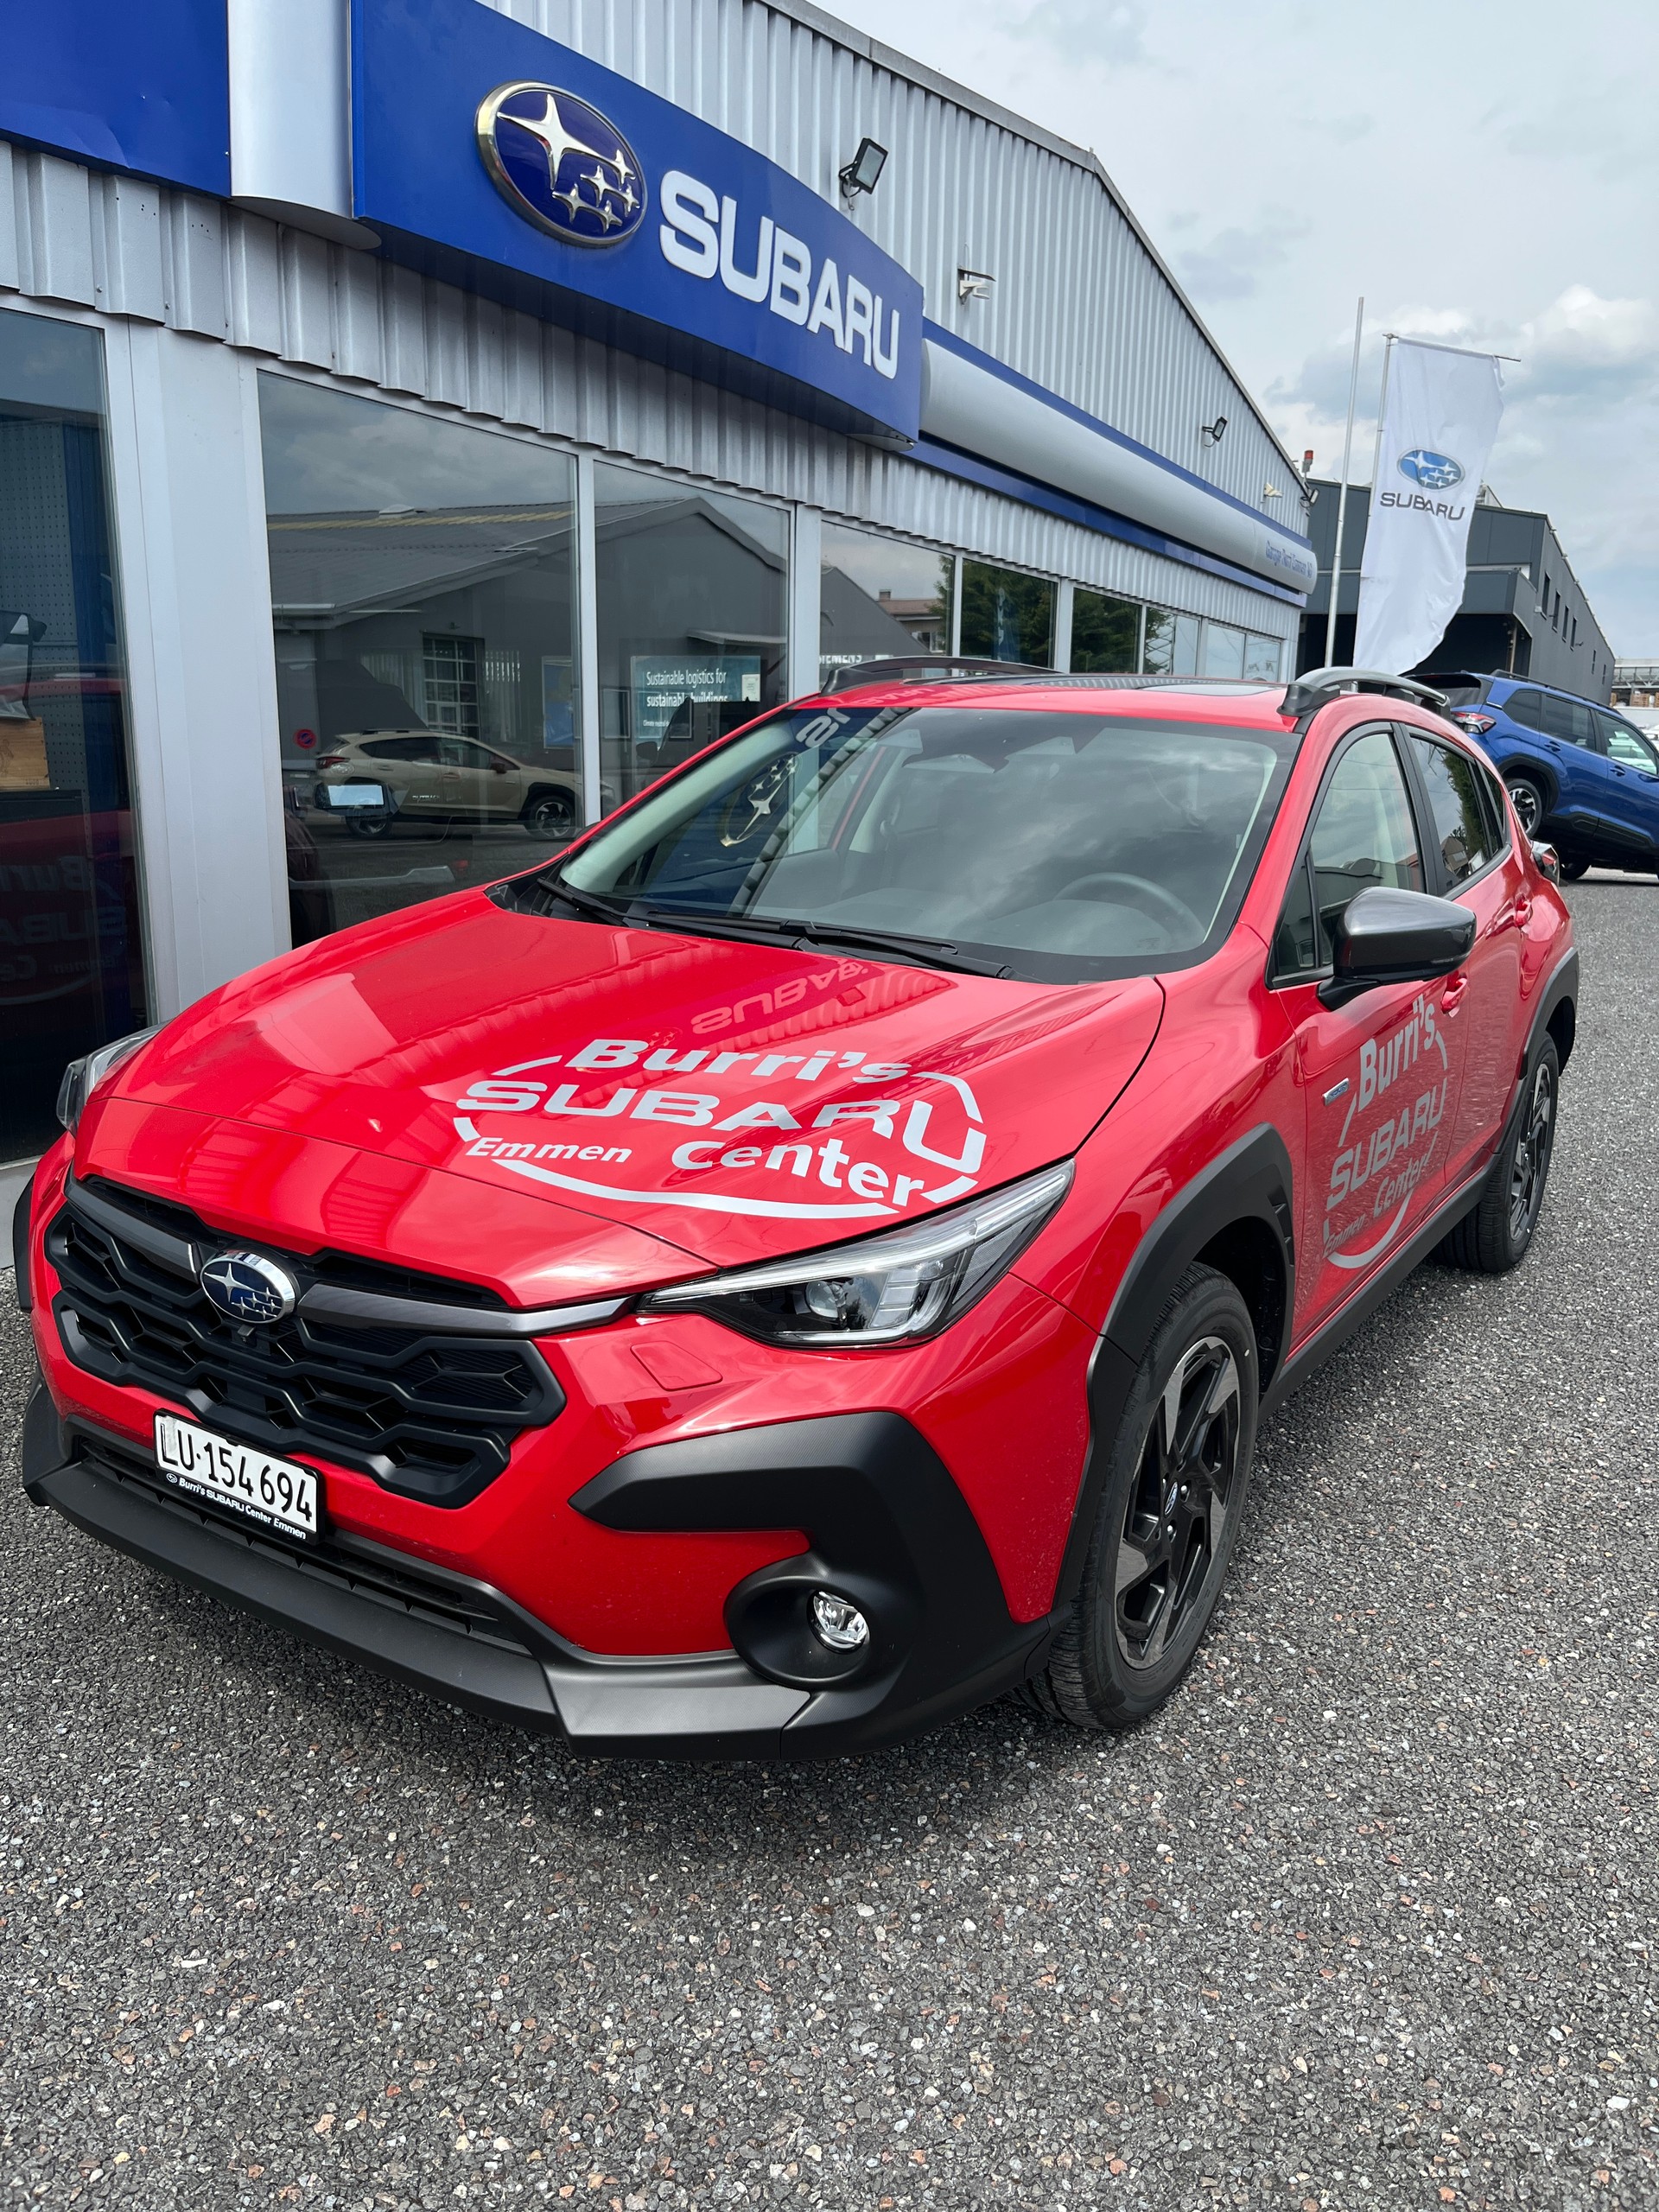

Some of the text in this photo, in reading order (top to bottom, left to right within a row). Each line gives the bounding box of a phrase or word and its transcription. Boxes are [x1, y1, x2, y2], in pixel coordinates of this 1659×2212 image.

[660, 170, 899, 380] SUBARU
[1380, 492, 1466, 521] SUBARU
[646, 668, 727, 689] Sustainable logistics for
[564, 1039, 913, 1084] Burri's
[1358, 994, 1435, 1113] Burri's
[454, 1080, 987, 1175] SUBARU
[1326, 1077, 1447, 1211] SUBARU
[465, 1137, 926, 1208] Emmen Center
[1323, 1154, 1427, 1259] Emmen Center
[179, 1477, 307, 1540] Burri's SUBARU Center Emmen
